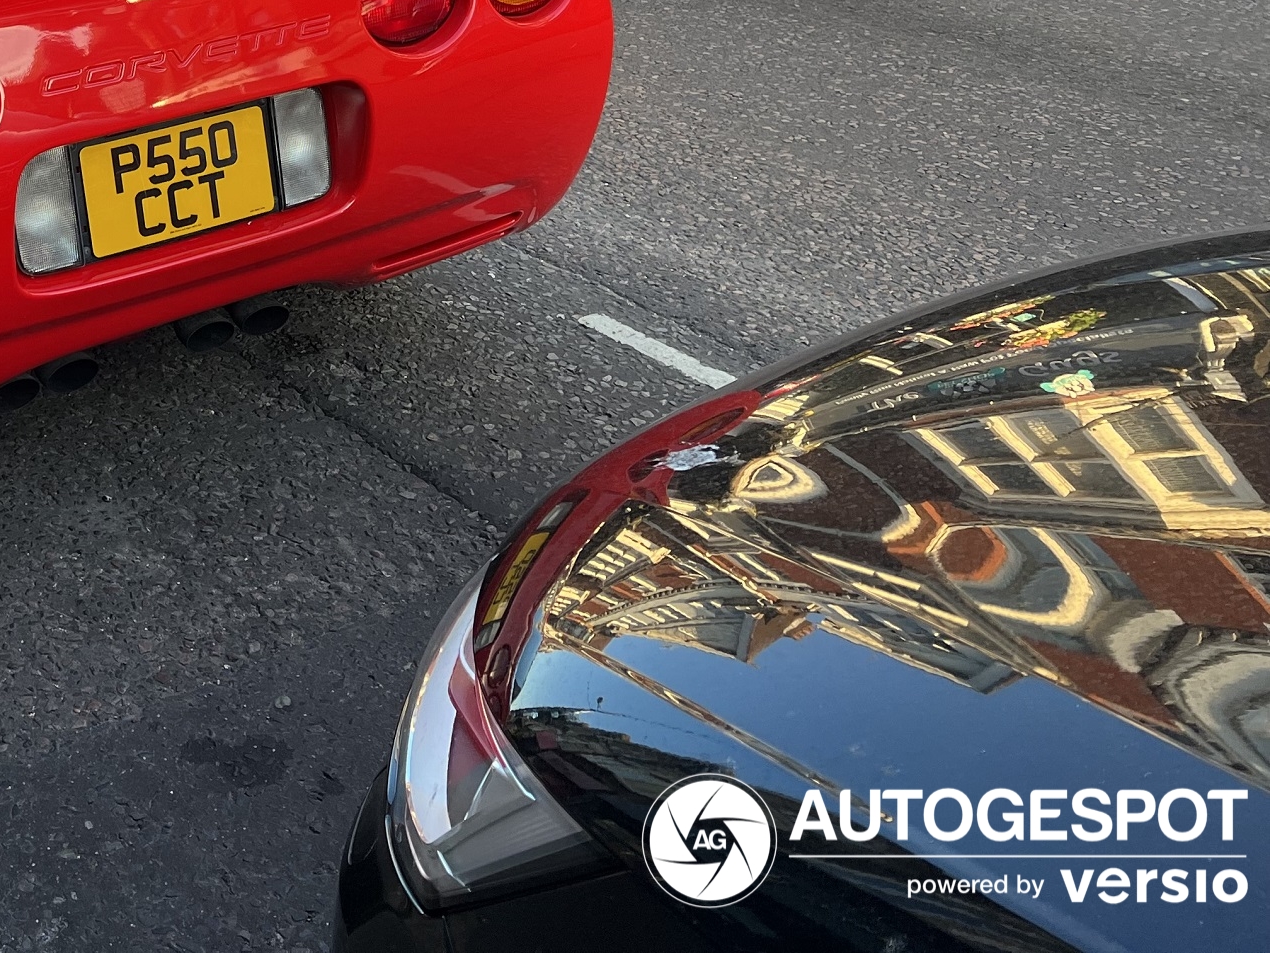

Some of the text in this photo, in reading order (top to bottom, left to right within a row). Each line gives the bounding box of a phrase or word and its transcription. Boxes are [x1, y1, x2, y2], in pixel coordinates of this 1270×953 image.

[41, 15, 331, 97] CORVETTE
[110, 120, 238, 195] P550
[134, 171, 226, 237] CCT
